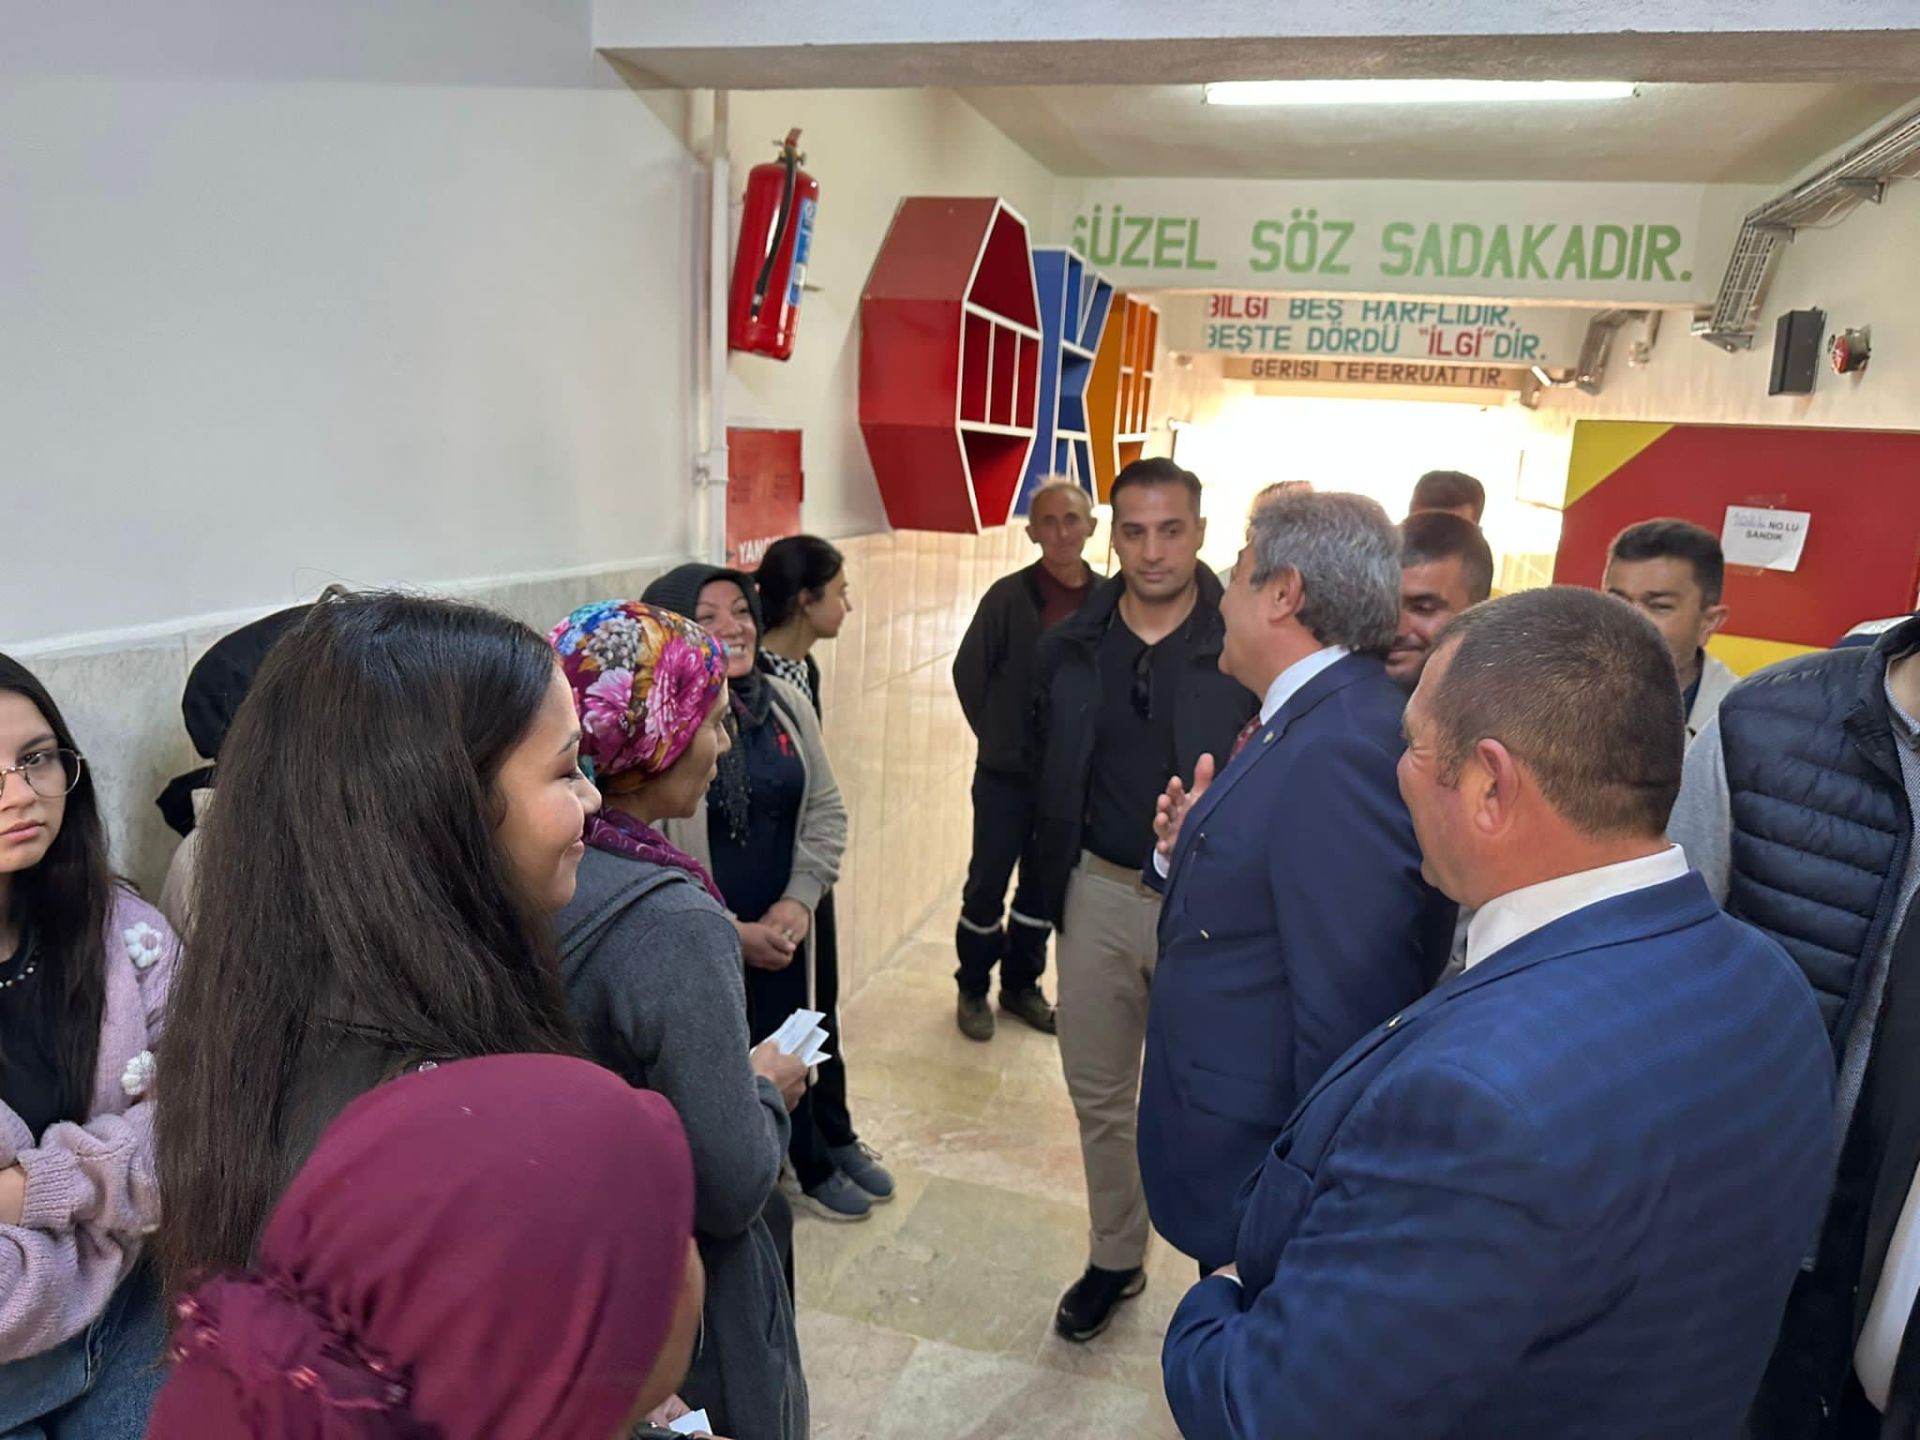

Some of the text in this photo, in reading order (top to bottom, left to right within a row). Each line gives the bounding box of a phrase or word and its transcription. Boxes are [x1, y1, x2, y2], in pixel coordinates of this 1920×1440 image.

[1249, 208, 1355, 274] SÖZ
[1379, 222, 1693, 282] SADAKADIR.
[1289, 298, 1344, 323] BEŞ
[1307, 321, 1400, 353] DÖRDÜ
[1745, 530, 1782, 541] SANDIK
[1768, 521, 1799, 532] NO LU
